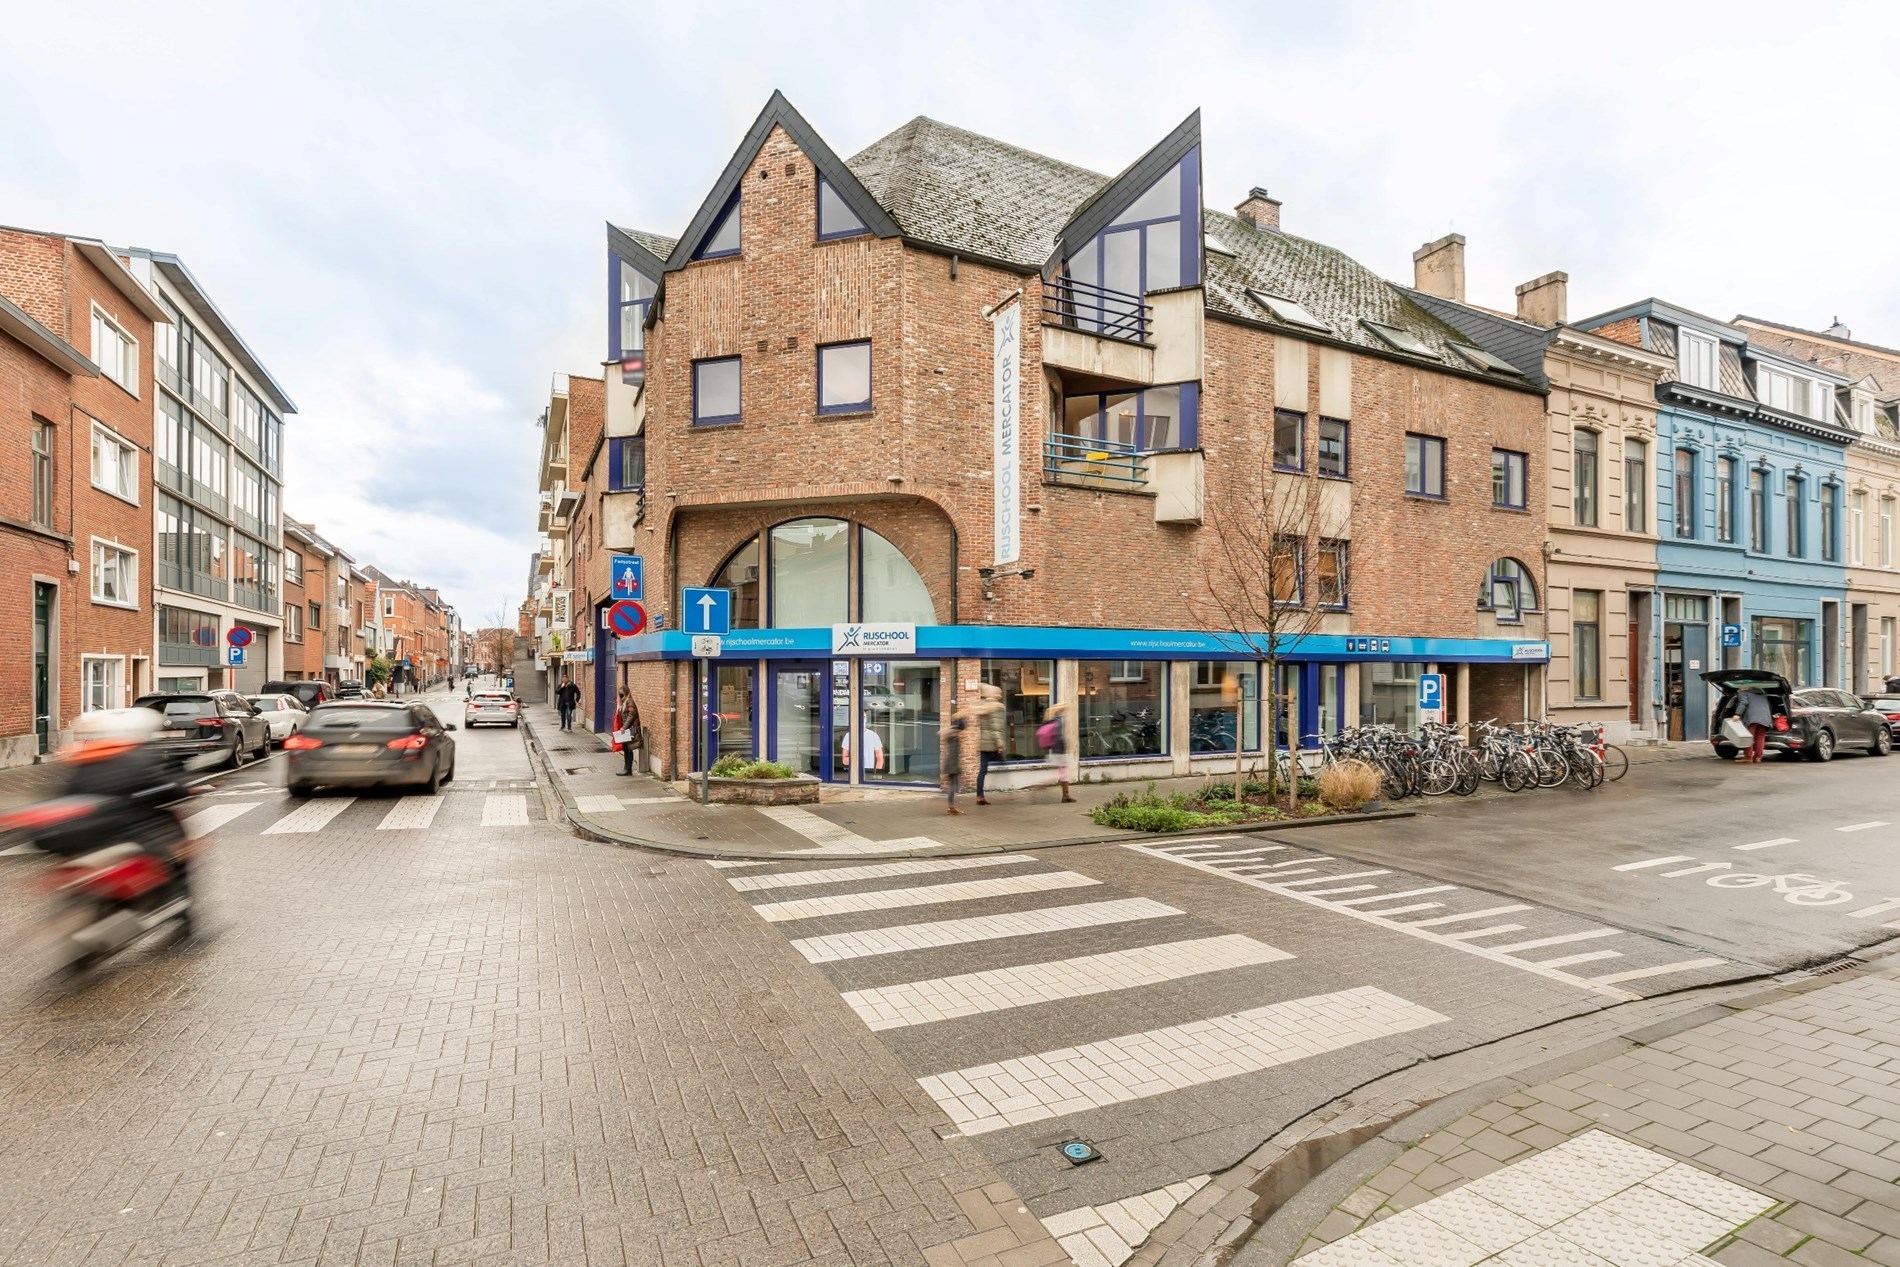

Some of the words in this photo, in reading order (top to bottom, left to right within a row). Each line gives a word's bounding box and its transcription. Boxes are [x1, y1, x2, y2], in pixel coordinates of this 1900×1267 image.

[1002, 354, 1012, 455] MERCATOR
[1001, 463, 1012, 560] RIJSCHOOL
[863, 631, 910, 640] RIJSCHOOL
[230, 648, 241, 660] P
[1423, 679, 1438, 703] P
